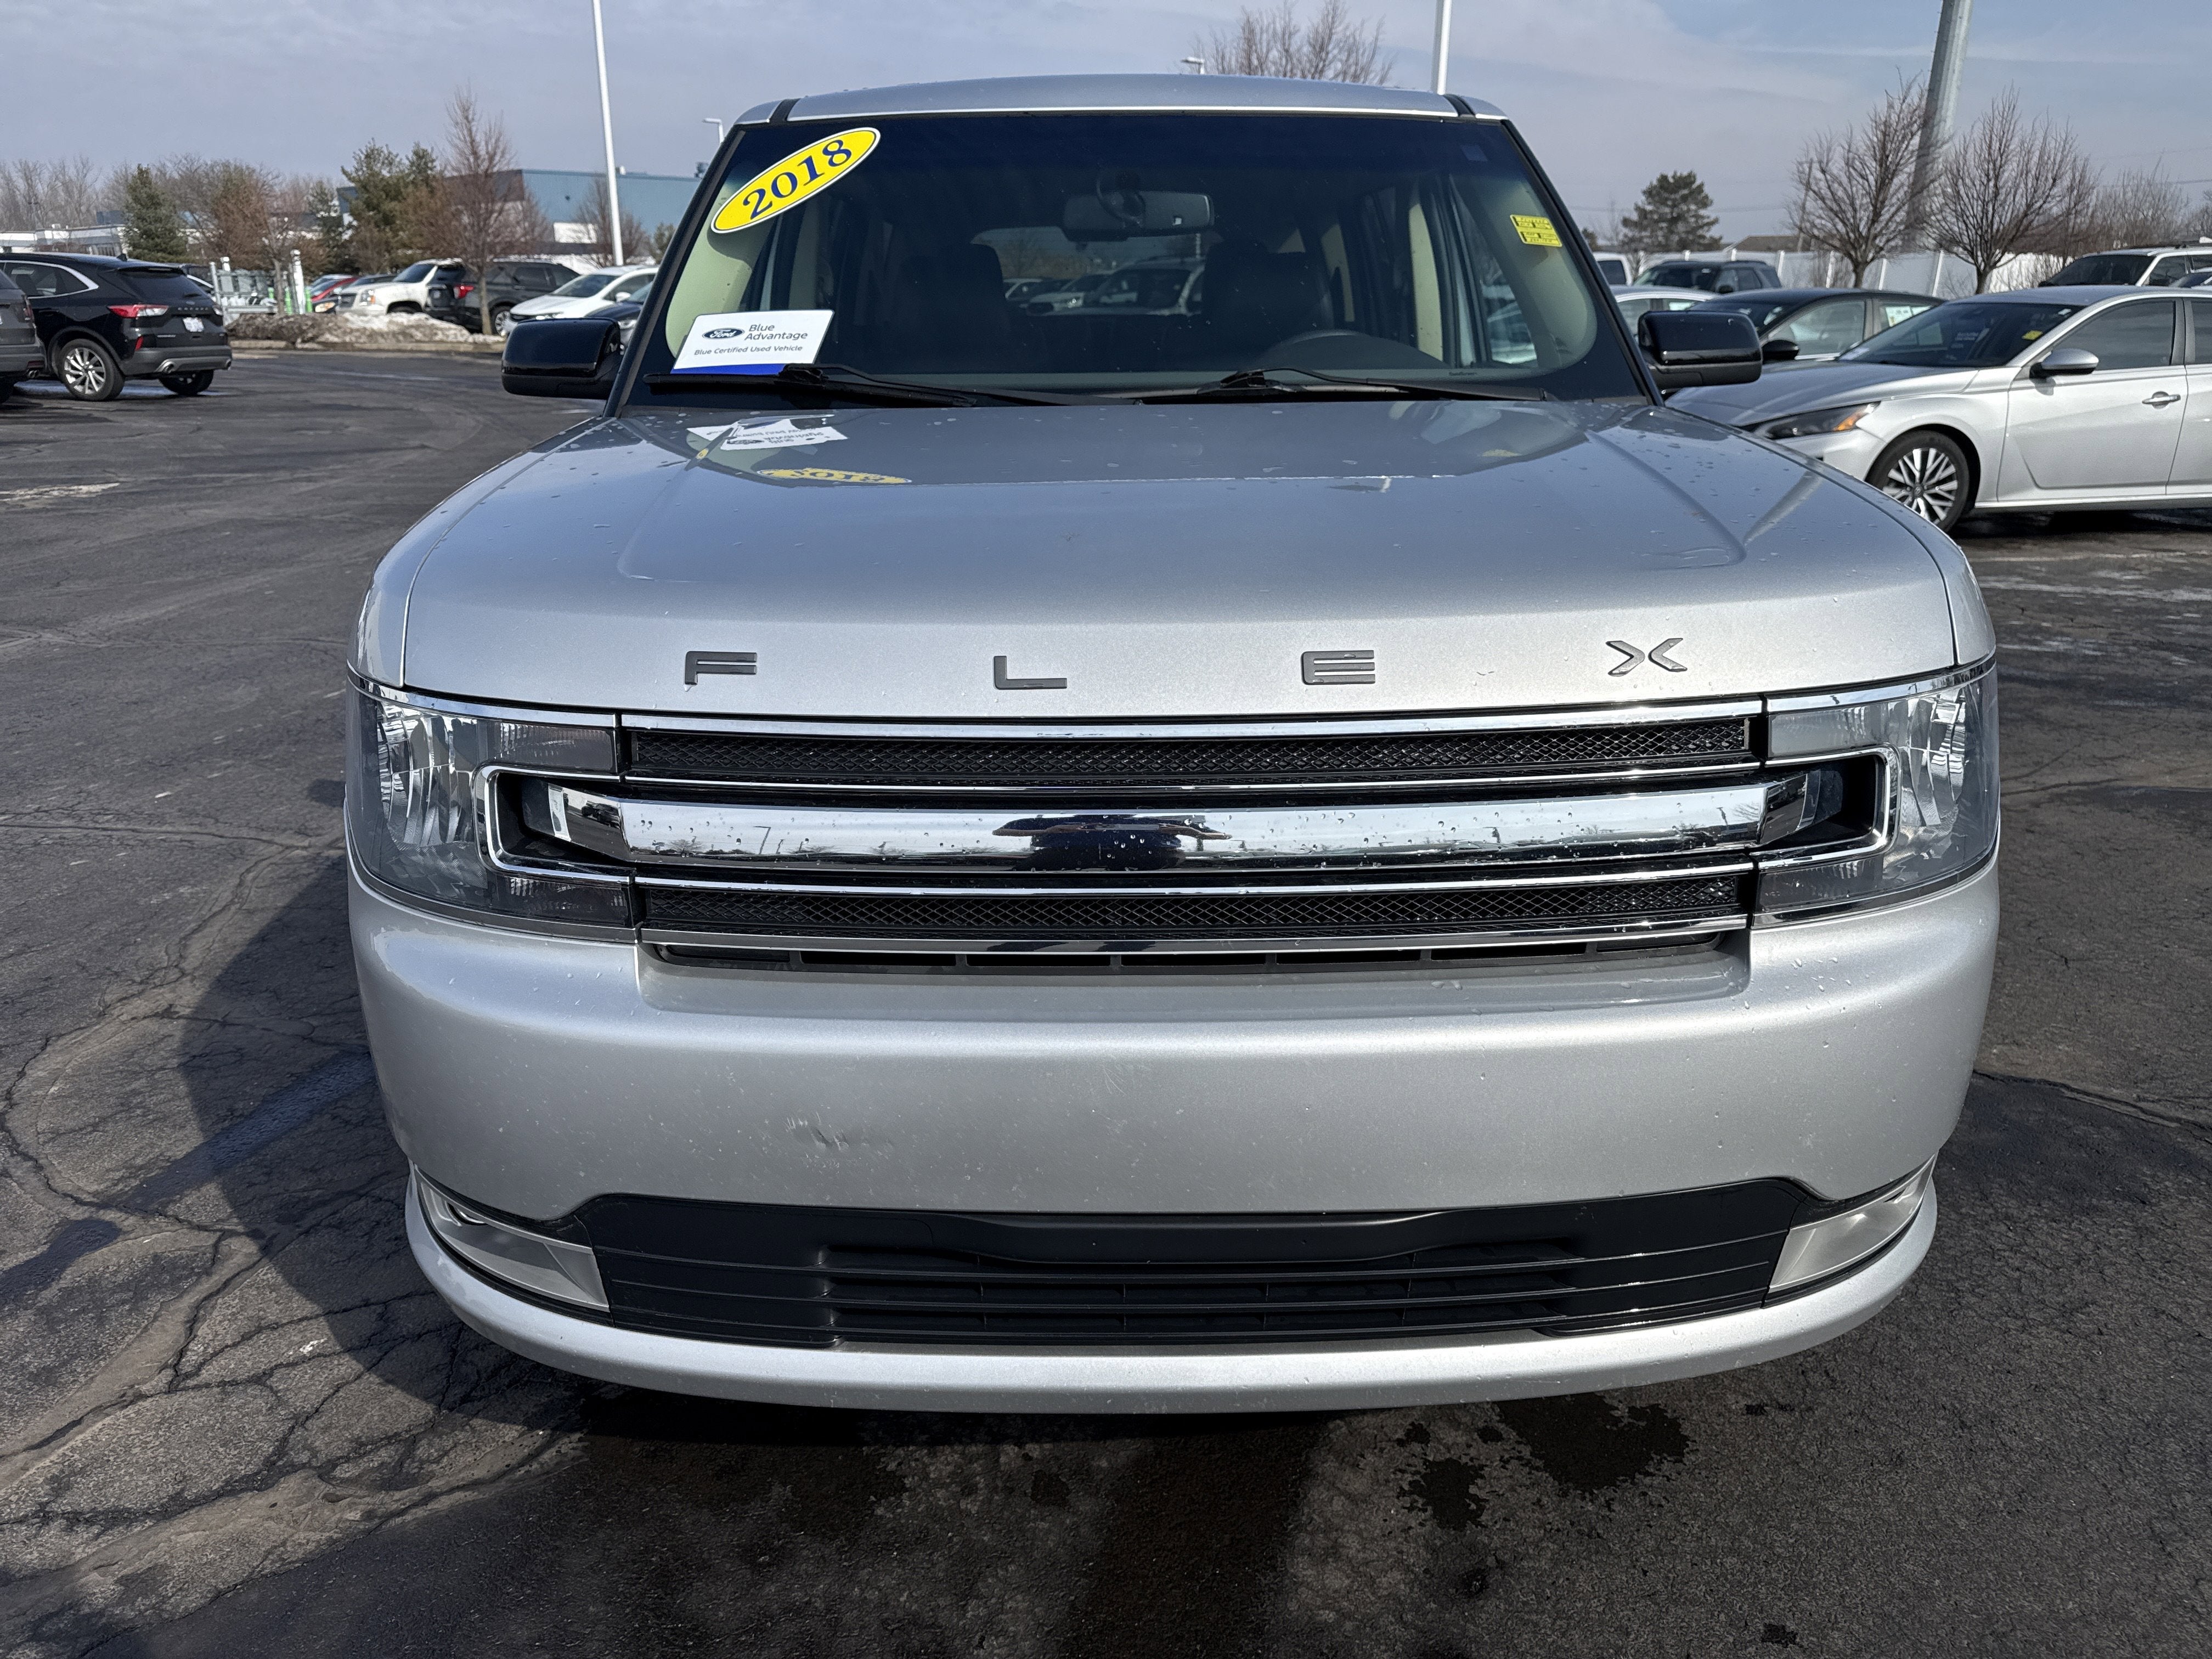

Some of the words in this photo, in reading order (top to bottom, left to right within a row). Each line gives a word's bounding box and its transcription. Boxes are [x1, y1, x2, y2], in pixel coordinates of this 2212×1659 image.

[743, 140, 852, 219] 2018
[744, 332, 808, 341] Advantage
[748, 324, 775, 332] Blue
[684, 637, 1688, 690] FLEX
